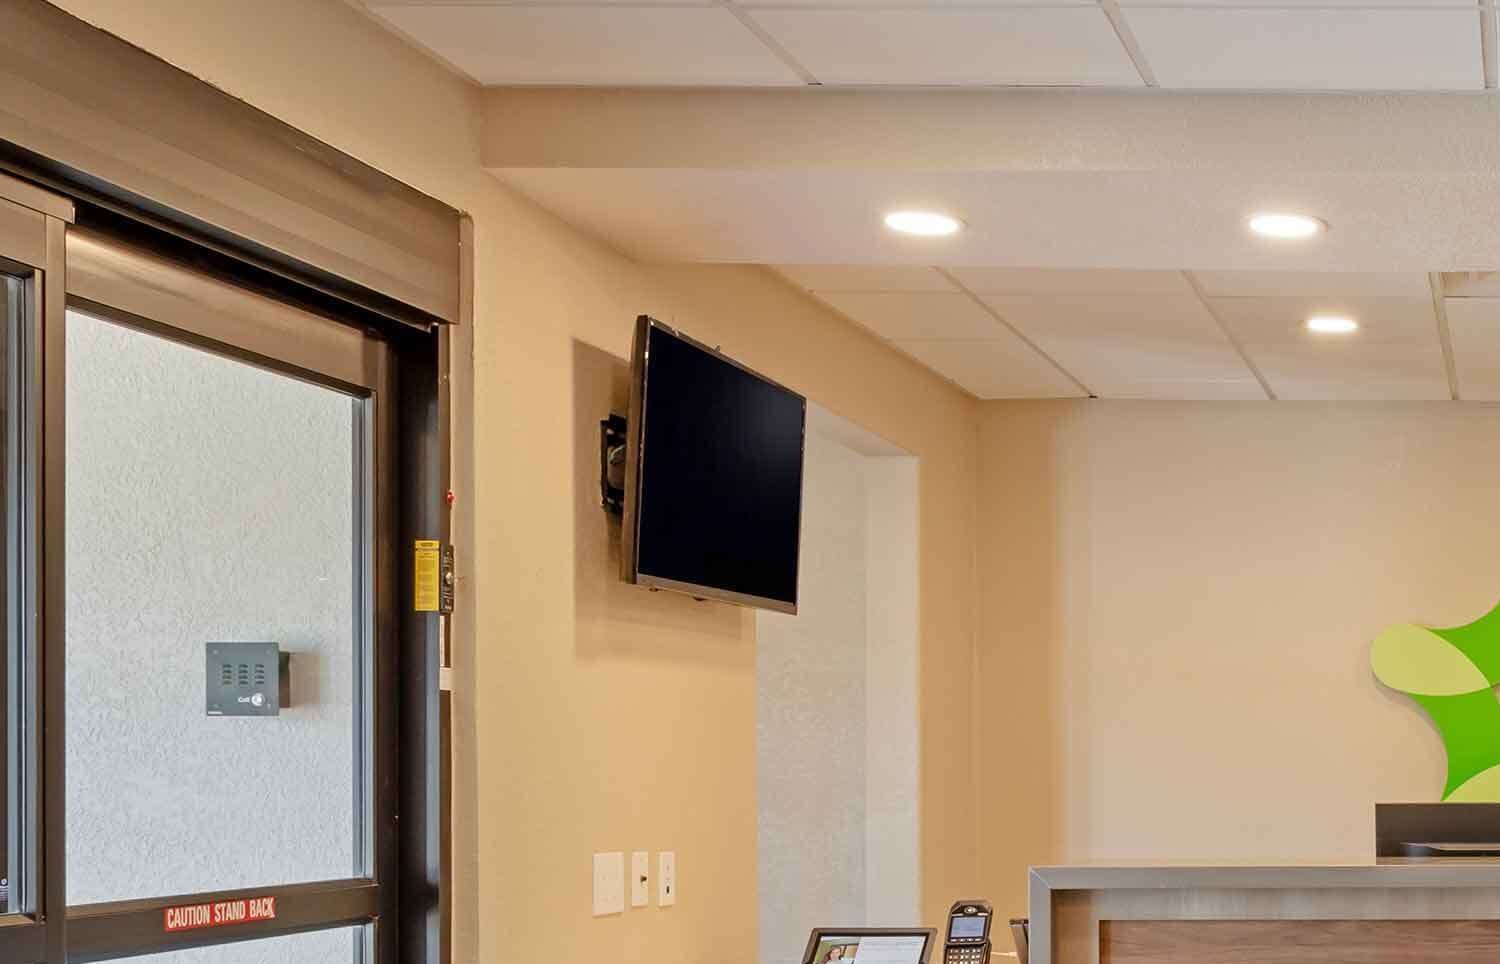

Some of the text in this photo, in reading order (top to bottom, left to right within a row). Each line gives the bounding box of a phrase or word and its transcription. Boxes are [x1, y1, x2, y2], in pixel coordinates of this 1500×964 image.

[167, 897, 275, 929] CAUTION STAND BACK
